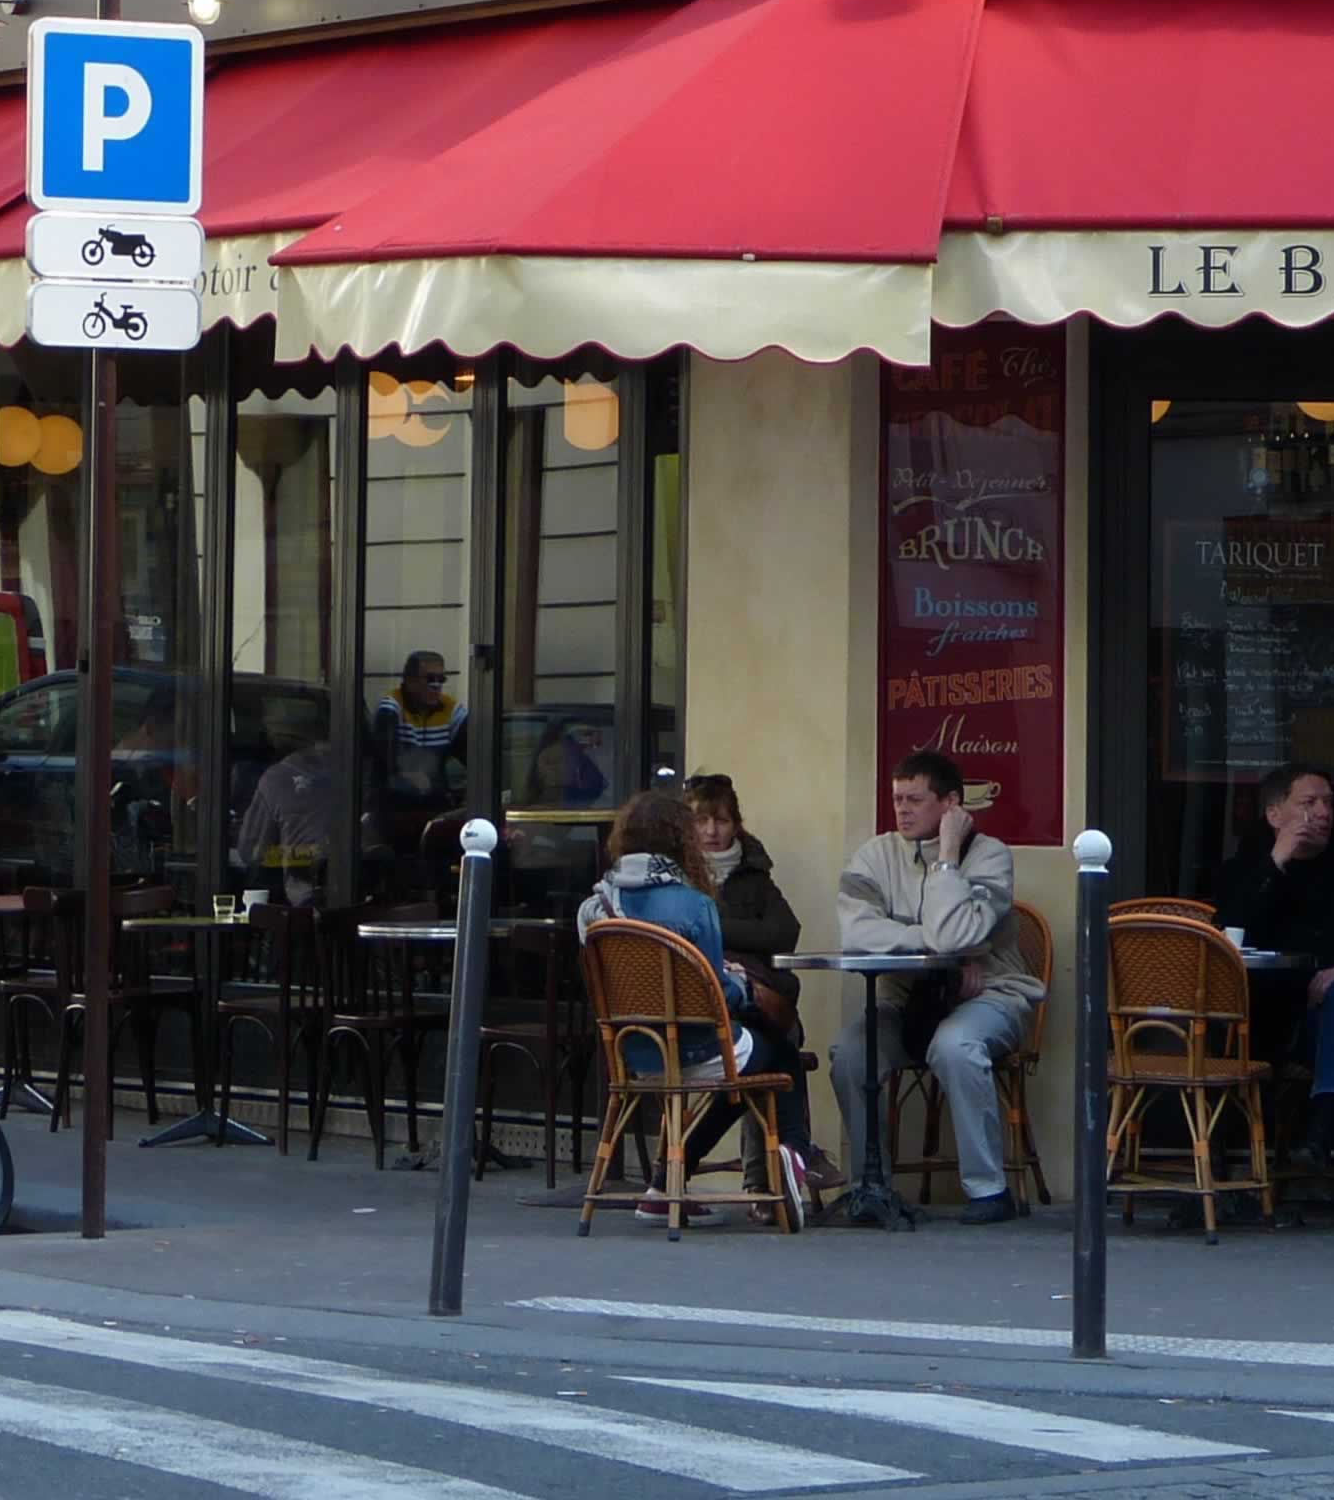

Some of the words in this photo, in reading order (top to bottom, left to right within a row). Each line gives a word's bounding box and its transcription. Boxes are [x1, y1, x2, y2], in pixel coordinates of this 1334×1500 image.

[82, 61, 153, 172] P
[1147, 244, 1245, 298] LE
[898, 516, 1044, 570] BRUNCH
[914, 587, 1038, 618] Boissons
[888, 664, 1054, 712] PÂTISSERIES
[912, 713, 1020, 754] Maison
